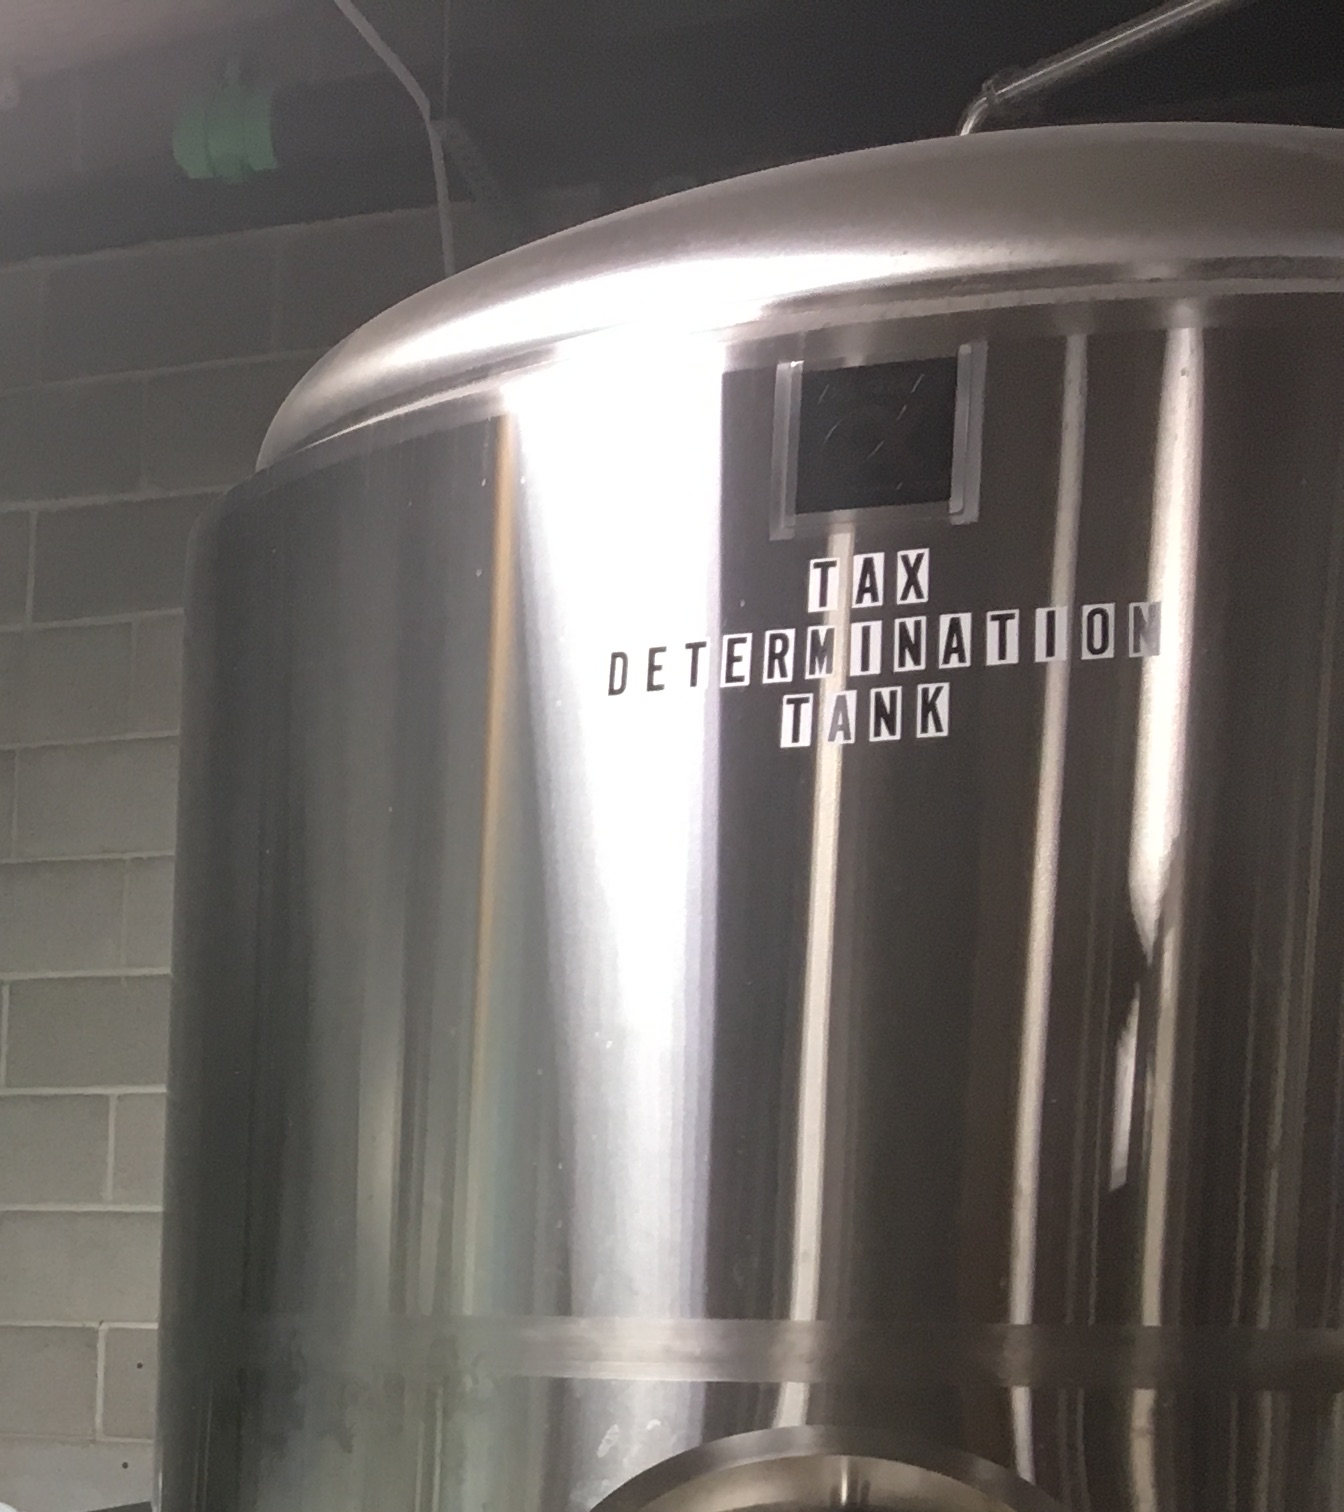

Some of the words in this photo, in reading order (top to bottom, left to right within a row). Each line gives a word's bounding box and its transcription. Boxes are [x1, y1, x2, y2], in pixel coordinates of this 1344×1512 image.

[812, 552, 925, 608] TAX
[608, 606, 1160, 696] DETERMINATION
[785, 685, 944, 744] TANK
